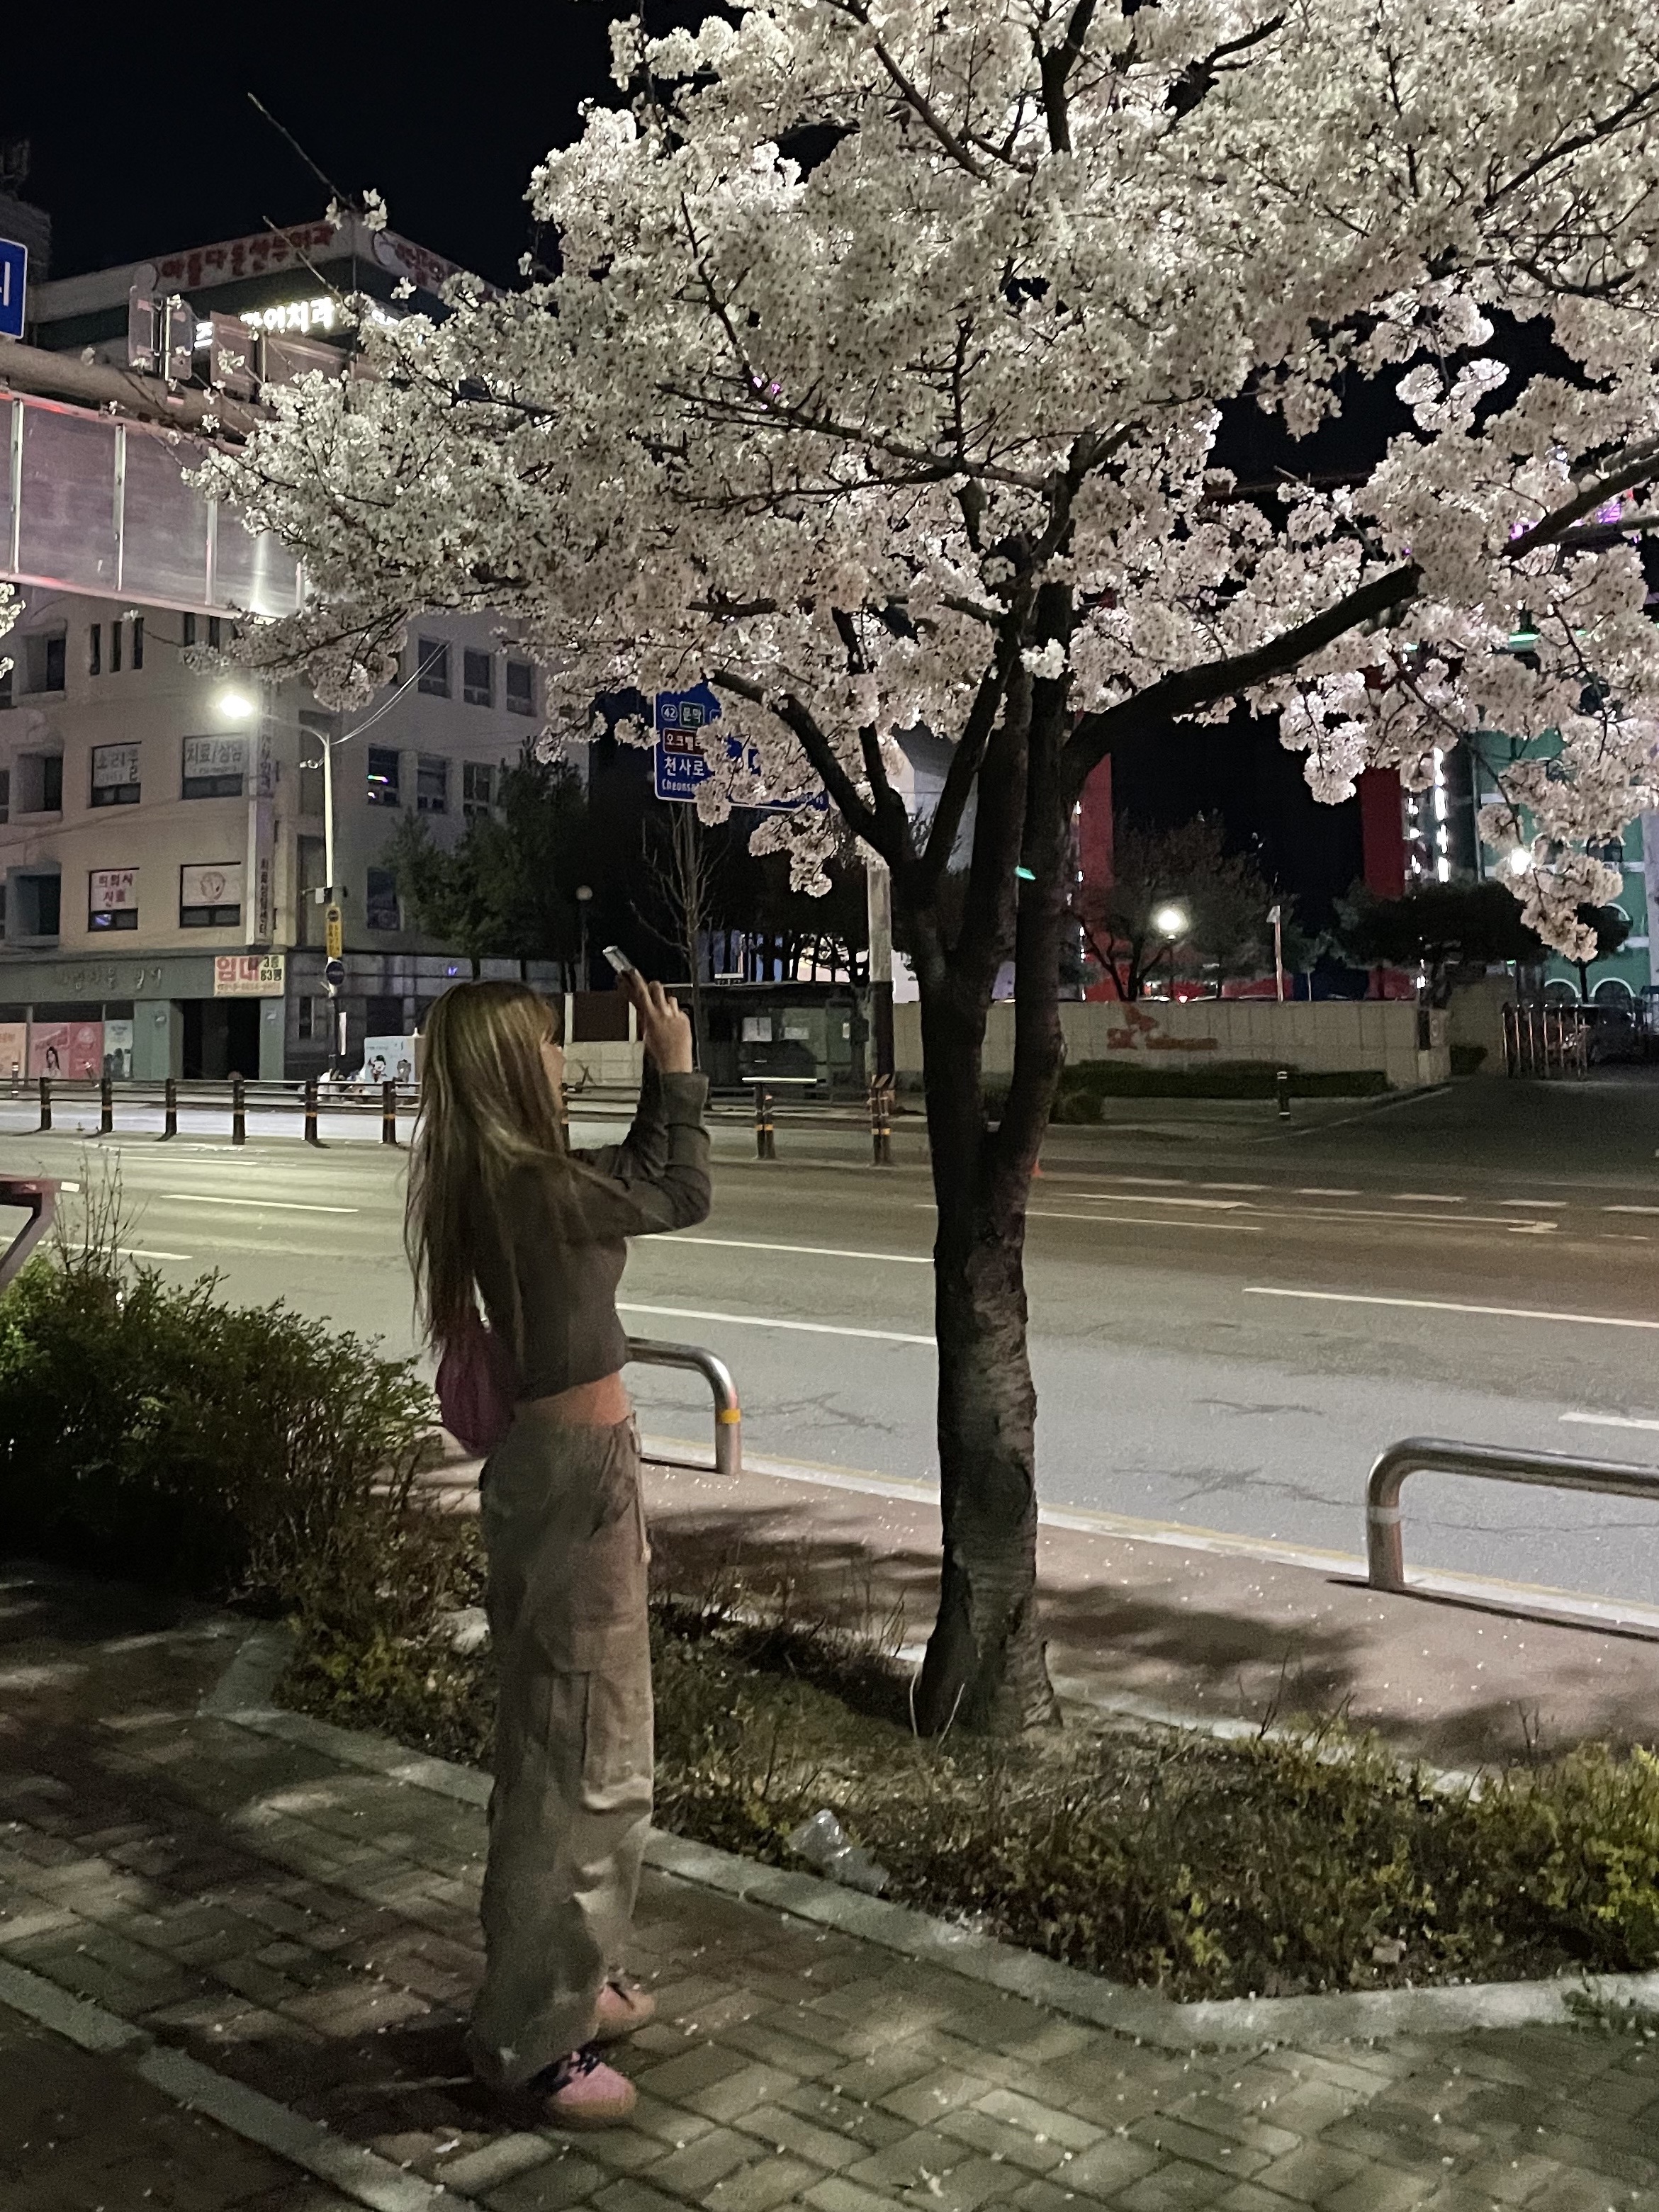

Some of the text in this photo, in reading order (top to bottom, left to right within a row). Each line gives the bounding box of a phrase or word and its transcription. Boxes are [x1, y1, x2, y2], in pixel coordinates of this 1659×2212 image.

[663, 708, 675, 718] 42
[683, 707, 701, 722] 문막
[664, 756, 704, 777] 천사로
[216, 957, 259, 981] 임대
